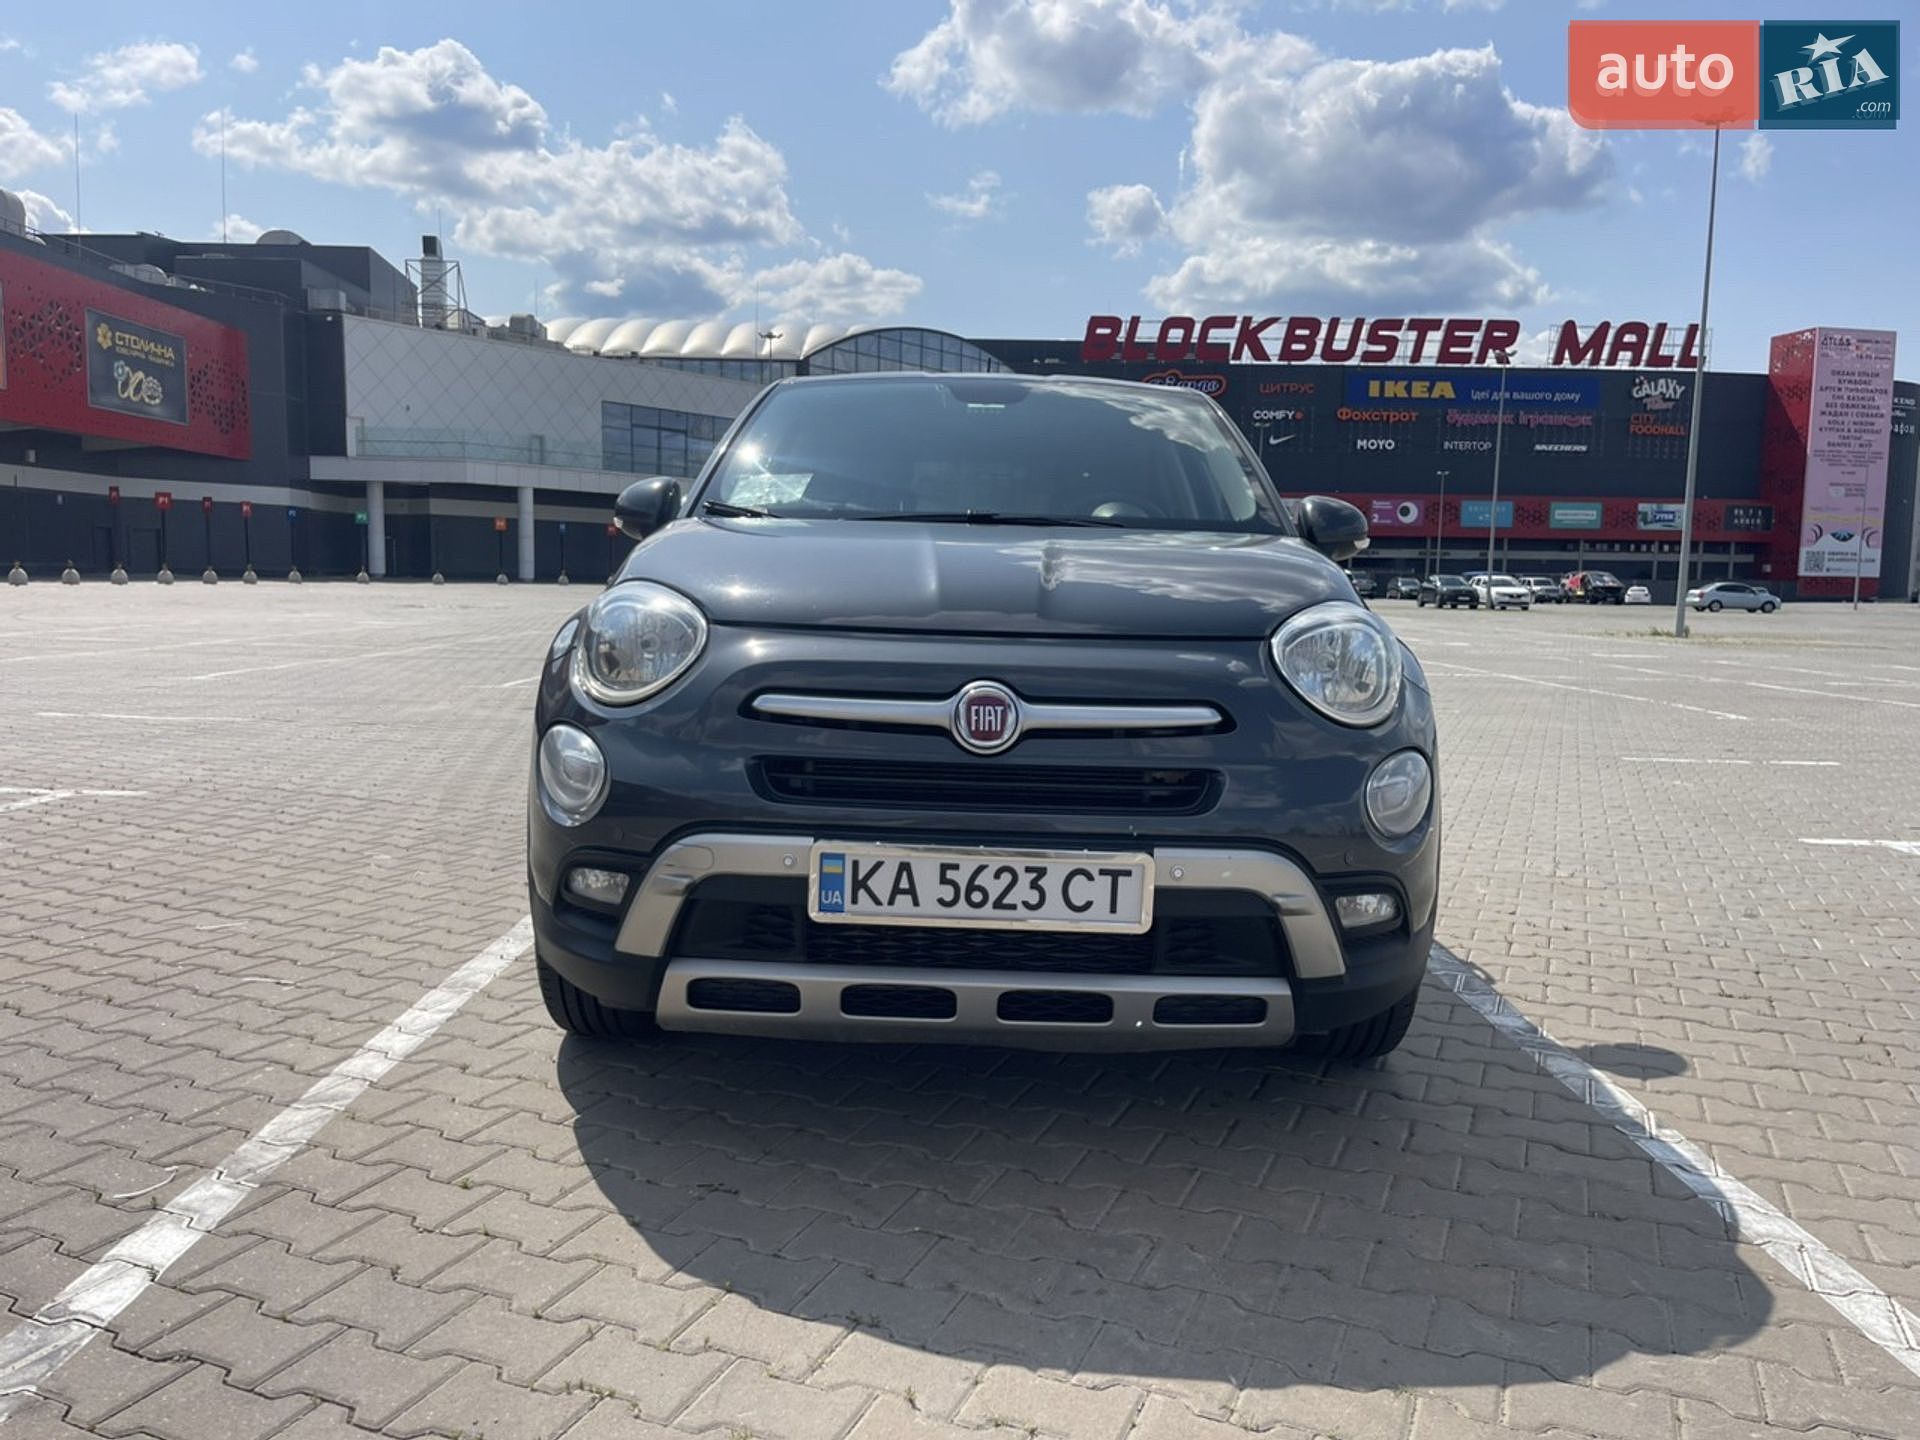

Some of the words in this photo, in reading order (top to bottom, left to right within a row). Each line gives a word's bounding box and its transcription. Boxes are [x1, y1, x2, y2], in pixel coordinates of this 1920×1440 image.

[115, 331, 175, 360] СТОЛИЧНА
[1082, 316, 1520, 365] BLOCKBUSTER
[1552, 319, 1706, 368] MALL
[1259, 383, 1316, 394] ЦИТРУС
[1368, 380, 1456, 398] IKEA
[1633, 378, 1686, 400] GALAXY
[1512, 391, 1552, 400] вашого
[1553, 392, 1581, 403] дому
[1252, 410, 1296, 420] COMFY
[1336, 407, 1419, 423] Фокстрот
[1630, 424, 1685, 435] FOODHALL
[1356, 439, 1396, 450] MOYO
[1443, 441, 1493, 451] INTERTOP
[970, 704, 1005, 732] FIAT
[850, 859, 920, 908] KA
[936, 862, 1048, 912] 5623
[1061, 867, 1133, 915] CT
[821, 890, 843, 906] UA
